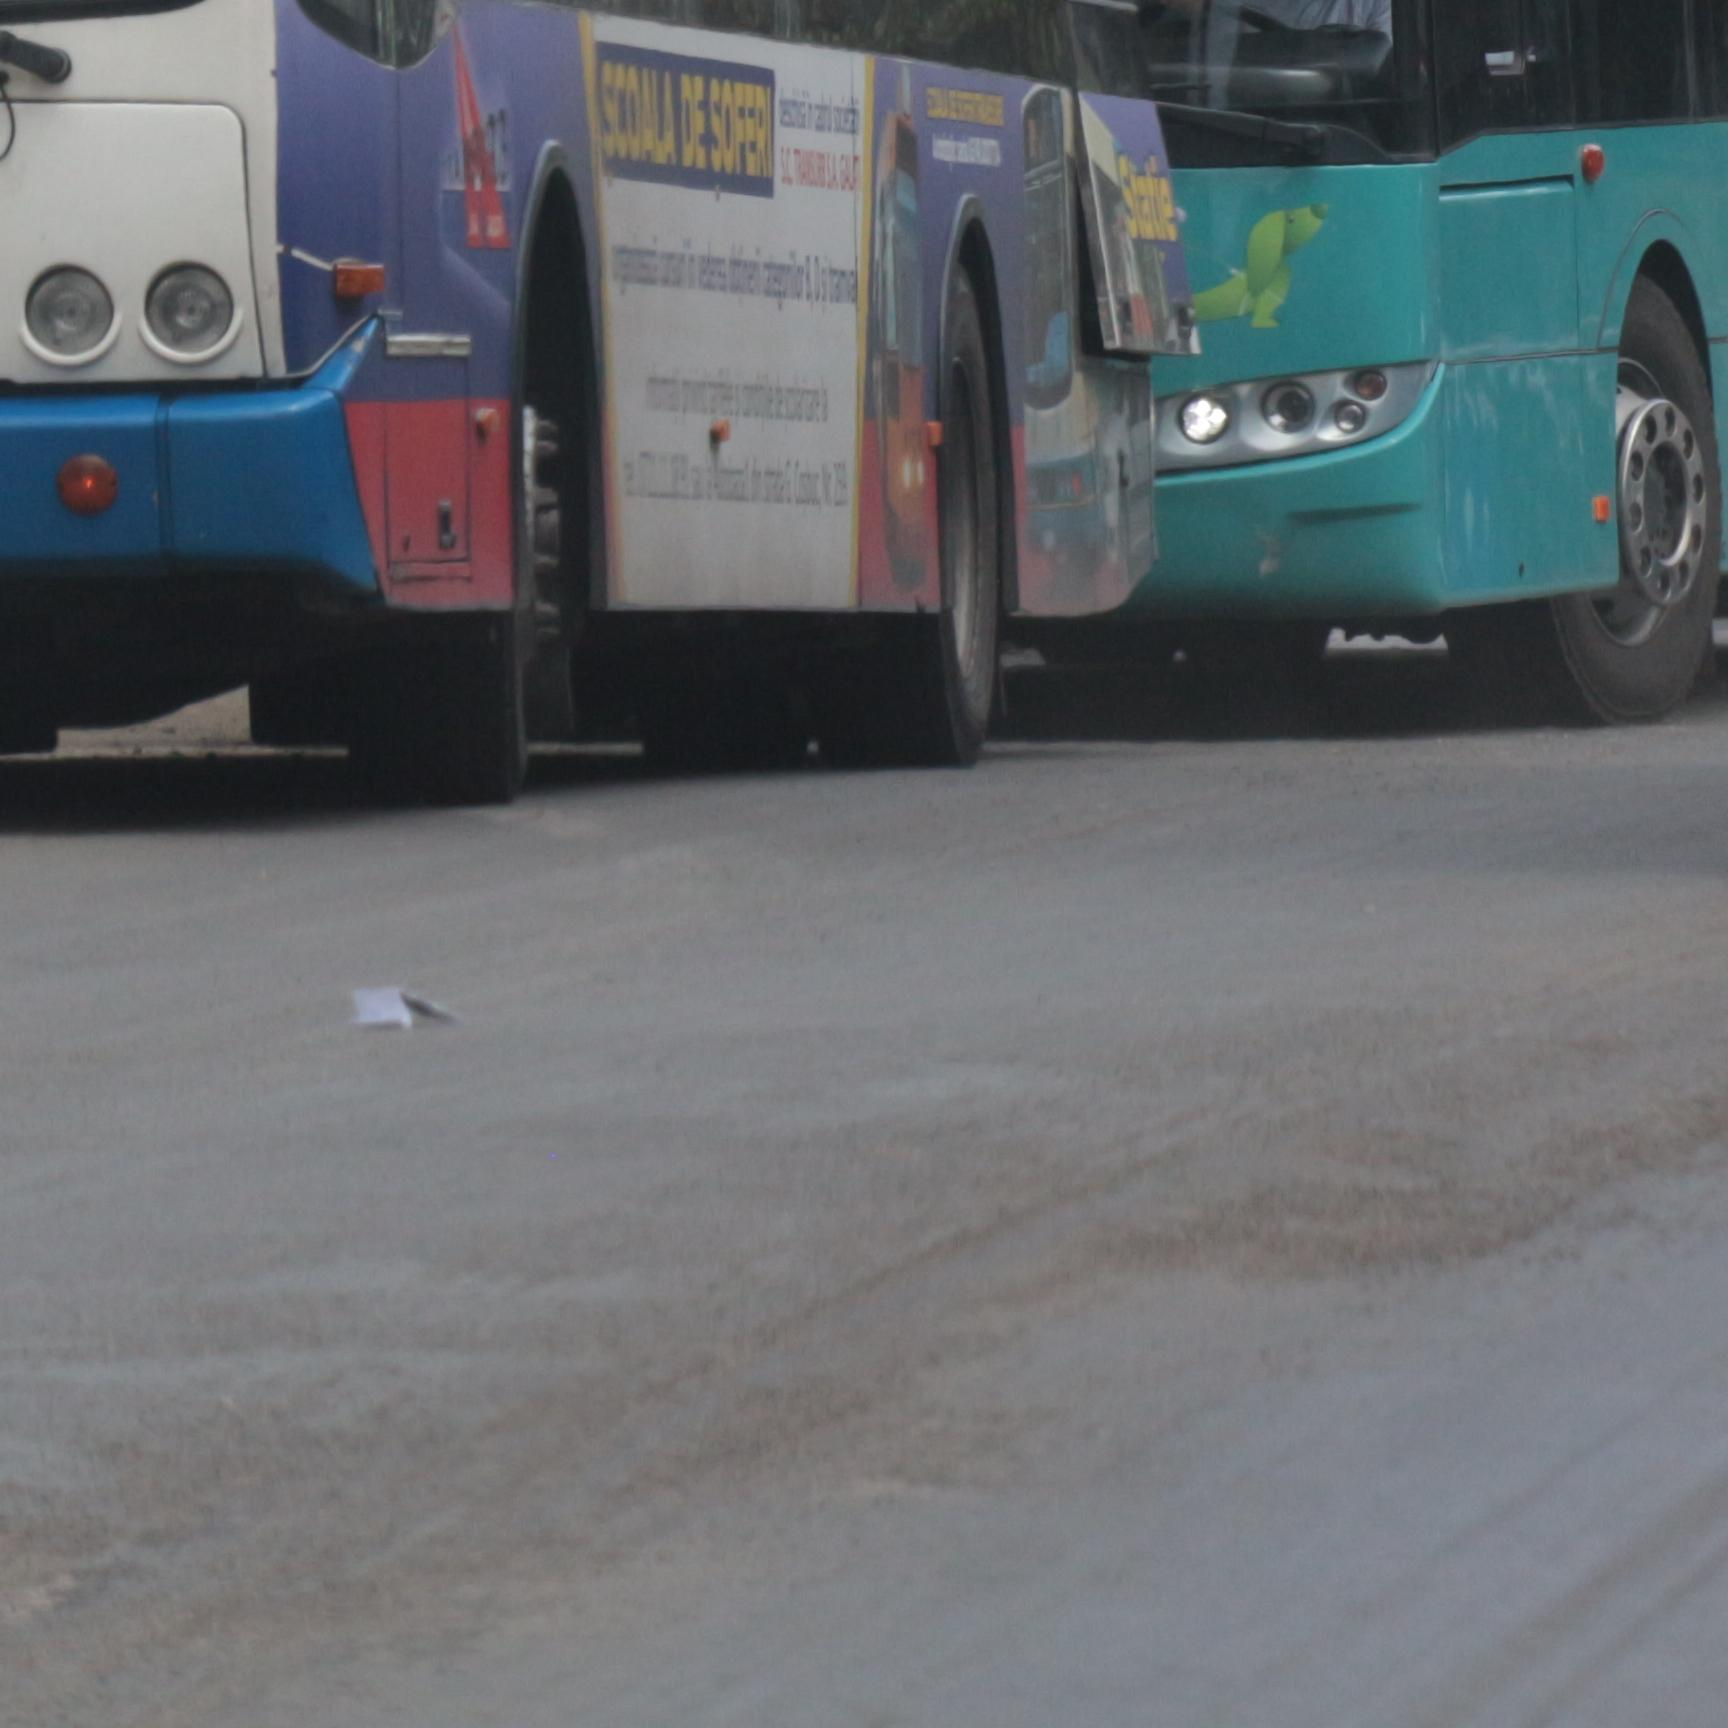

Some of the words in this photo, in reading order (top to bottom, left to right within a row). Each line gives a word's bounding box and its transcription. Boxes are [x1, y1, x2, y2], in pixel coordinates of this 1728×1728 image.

[602, 60, 677, 166] SCOALA
[681, 72, 707, 170] DE
[709, 78, 772, 177] SOFERI
